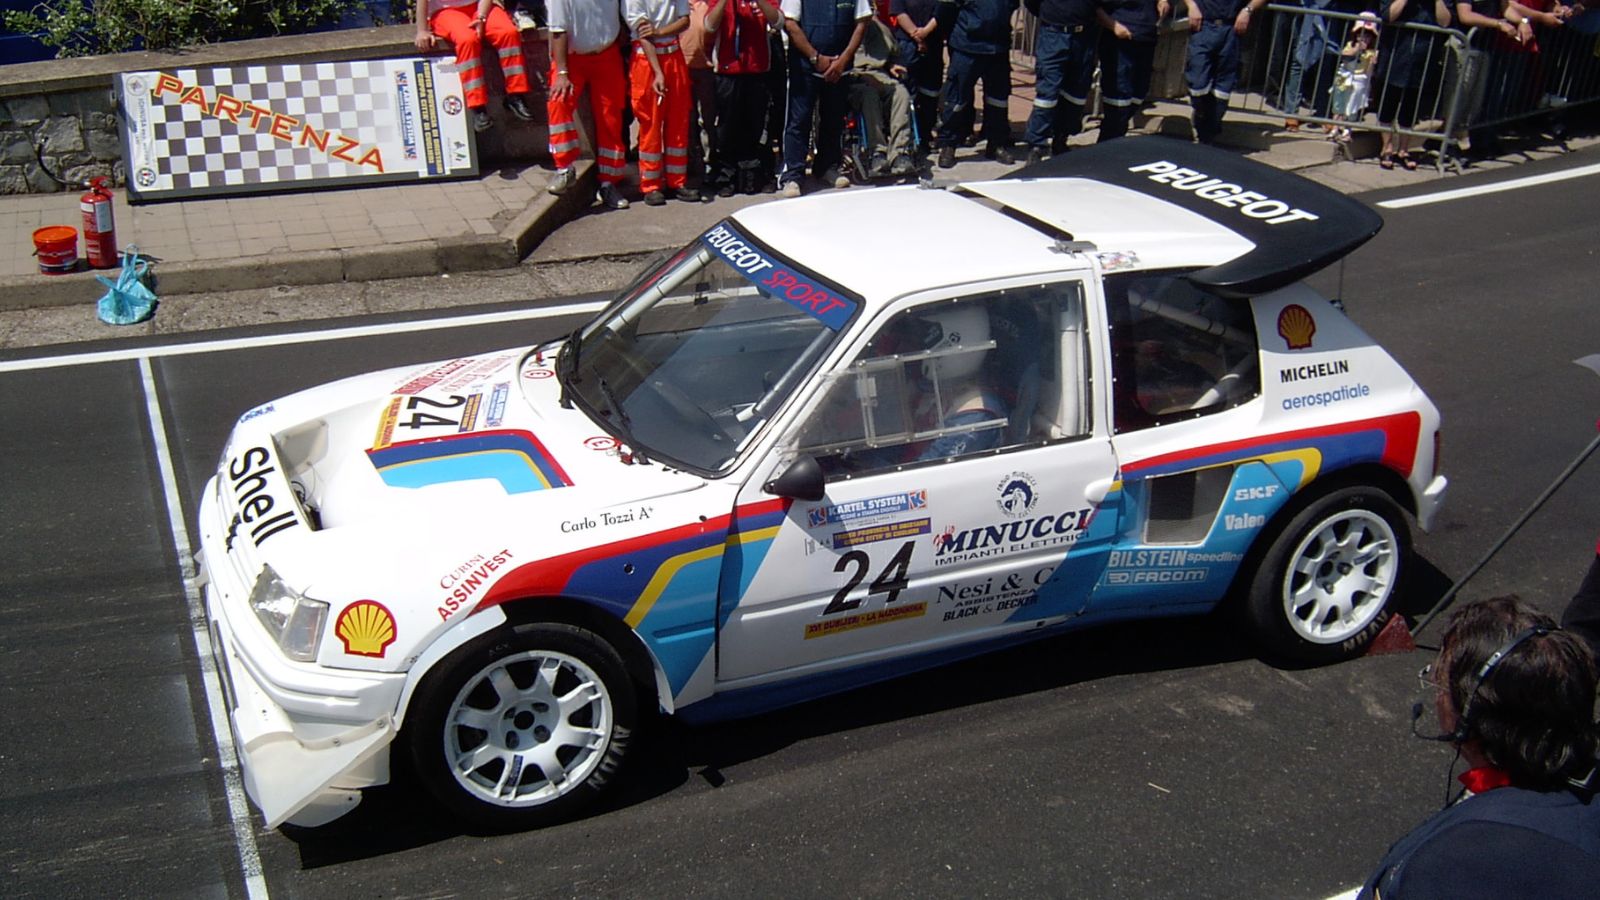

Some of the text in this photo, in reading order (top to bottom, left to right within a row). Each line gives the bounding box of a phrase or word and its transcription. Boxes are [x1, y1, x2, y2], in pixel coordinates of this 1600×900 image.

[154, 72, 385, 173] PARTENZA
[1128, 160, 1319, 224] PEUGEOT
[705, 226, 846, 315] PEUGEOT SPORT
[1280, 359, 1349, 383] MICHELIN
[398, 395, 466, 429] 24
[1282, 383, 1370, 410] aerospatiale
[229, 446, 299, 548] Shell
[828, 501, 867, 516] KARTEL
[868, 495, 907, 510] SYSTEM
[1234, 485, 1279, 501] SKF
[560, 516, 597, 533] Carlo
[600, 509, 634, 526] Tozzi
[936, 508, 1091, 556] MINUCCI
[1225, 513, 1265, 531] Valeo
[935, 532, 1089, 567] IMPIANTI ELETTRICI
[1108, 550, 1188, 568] BILSTEIN
[437, 549, 514, 622] ASSINVEST
[440, 554, 485, 589] CURINI
[823, 541, 915, 617] 24
[938, 566, 1060, 604] Nesi & C.
[943, 595, 1040, 622] BLACK & DECKER
[955, 587, 1038, 608] ASSISTENZA
